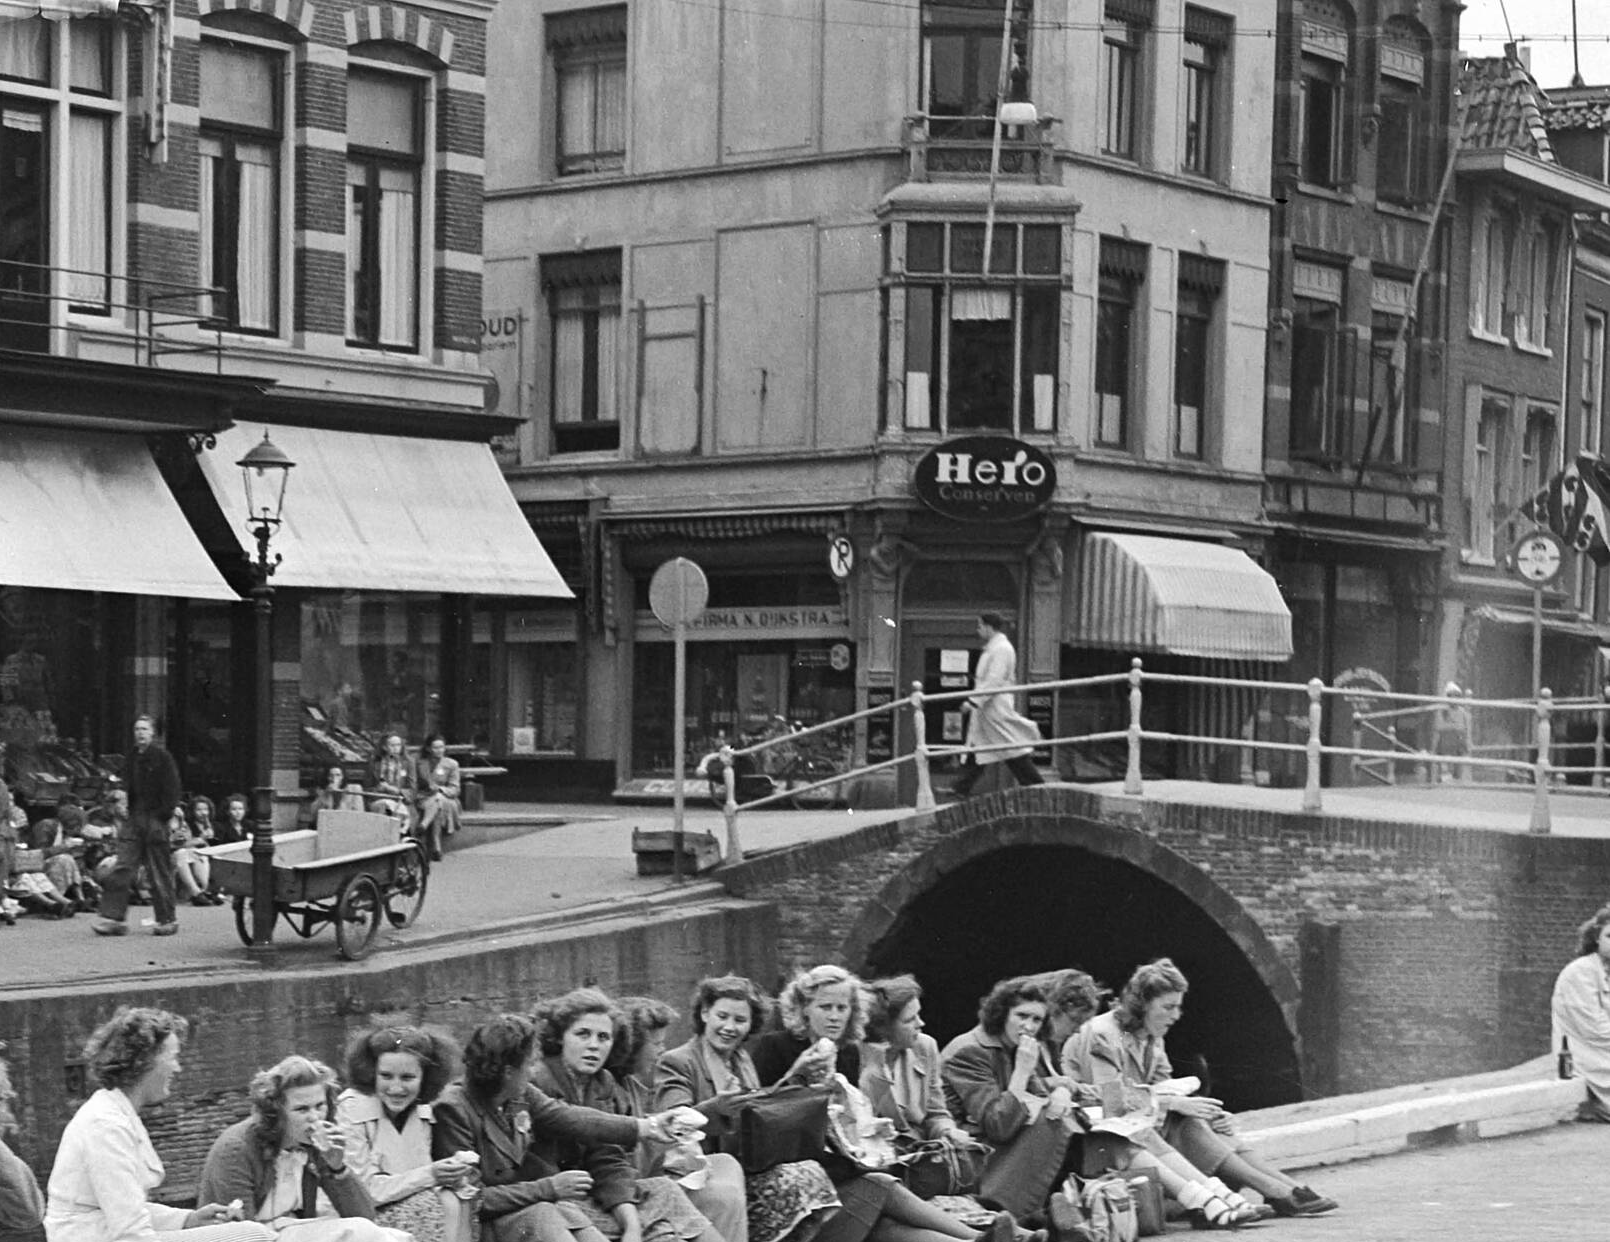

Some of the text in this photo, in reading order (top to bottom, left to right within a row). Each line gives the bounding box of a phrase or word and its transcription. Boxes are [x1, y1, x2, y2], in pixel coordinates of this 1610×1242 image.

[934, 449, 1046, 487] Hero
[939, 485, 1036, 503] Conserven
[692, 610, 739, 628] FIRMA
